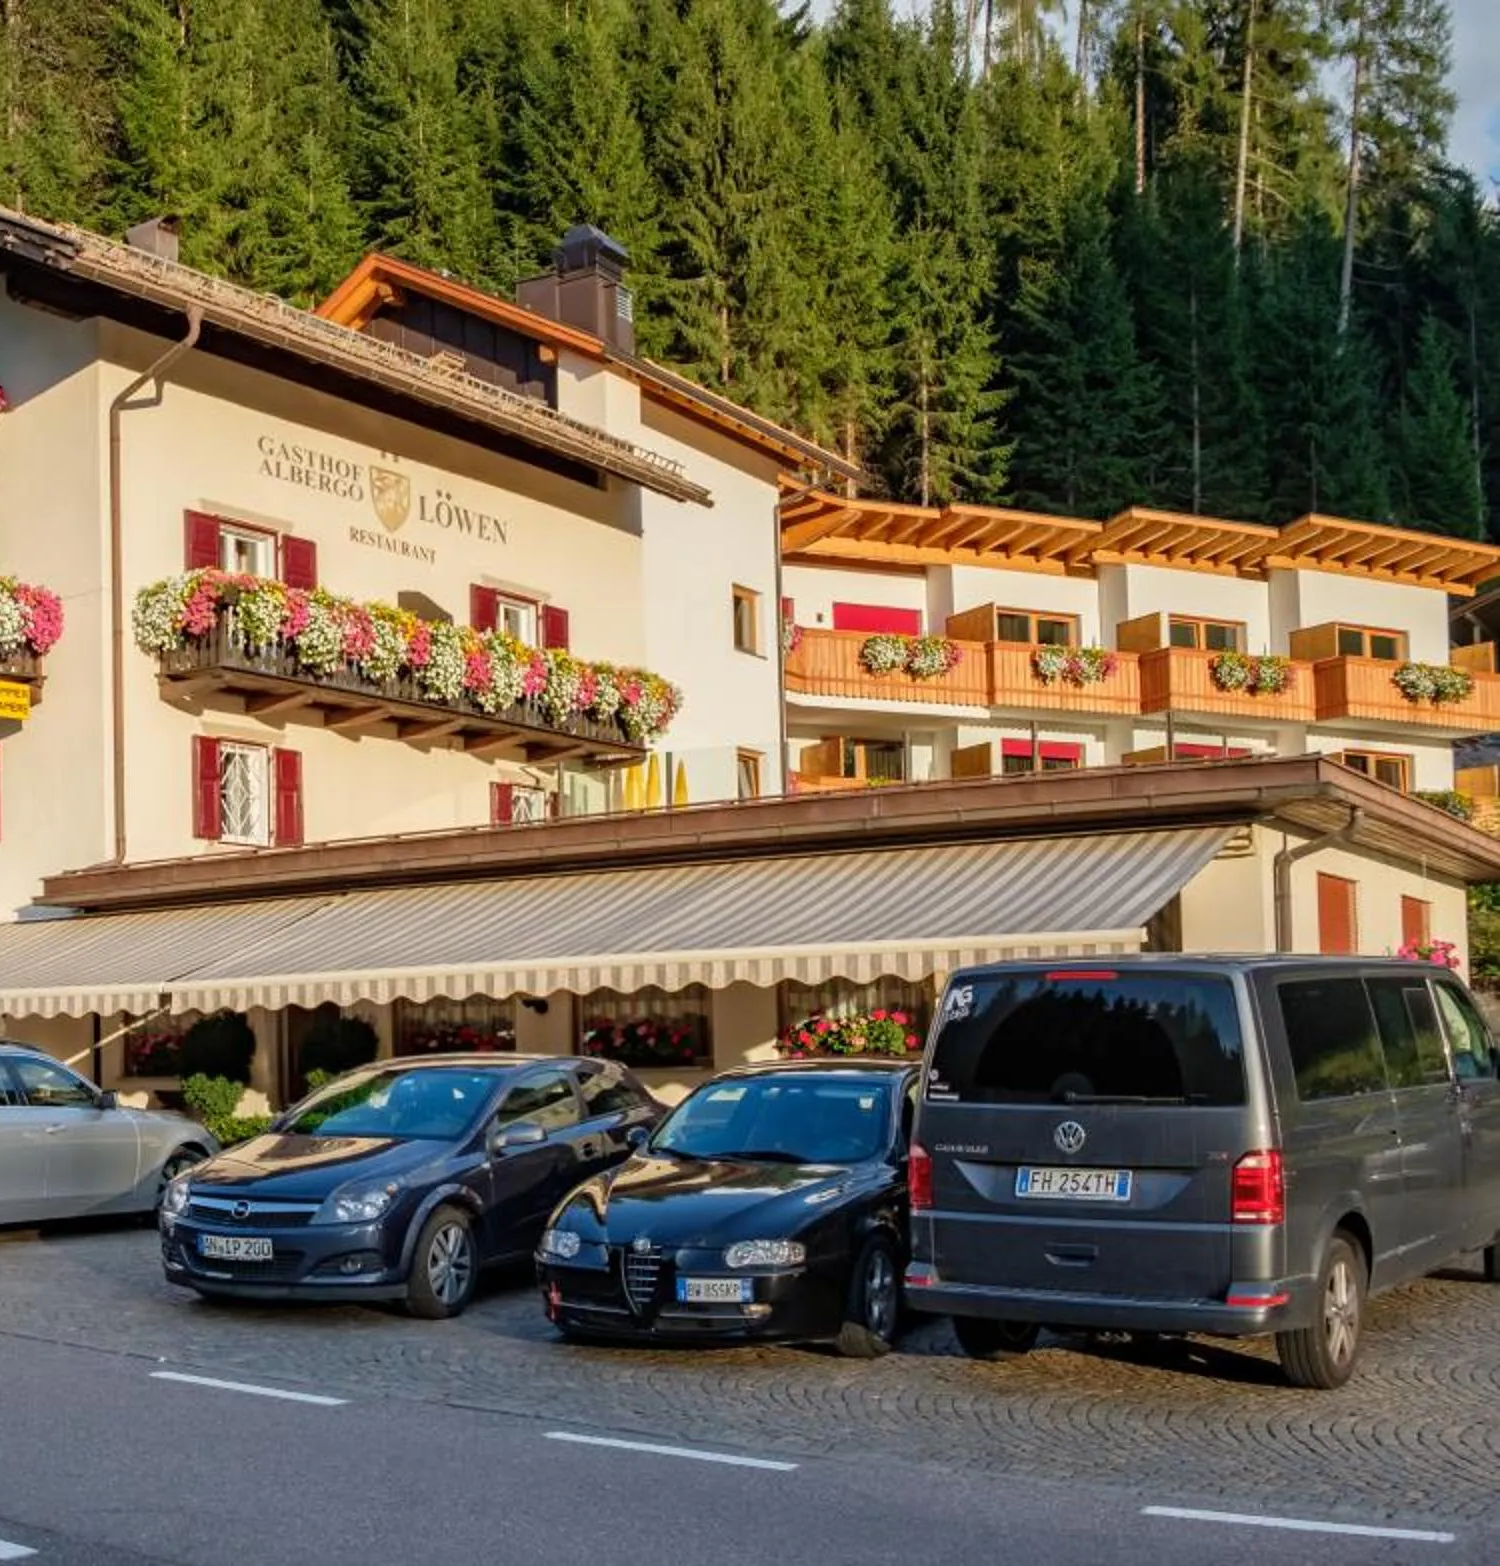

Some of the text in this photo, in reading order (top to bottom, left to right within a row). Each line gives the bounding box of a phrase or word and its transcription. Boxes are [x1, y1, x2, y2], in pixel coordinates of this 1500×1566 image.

[257, 435, 364, 481] GASTHOF
[259, 458, 364, 502] ALBERGO
[419, 489, 509, 545] LÖWEN
[349, 526, 437, 564] RESTAURANT
[1031, 1171, 1116, 1193] FH 254TH
